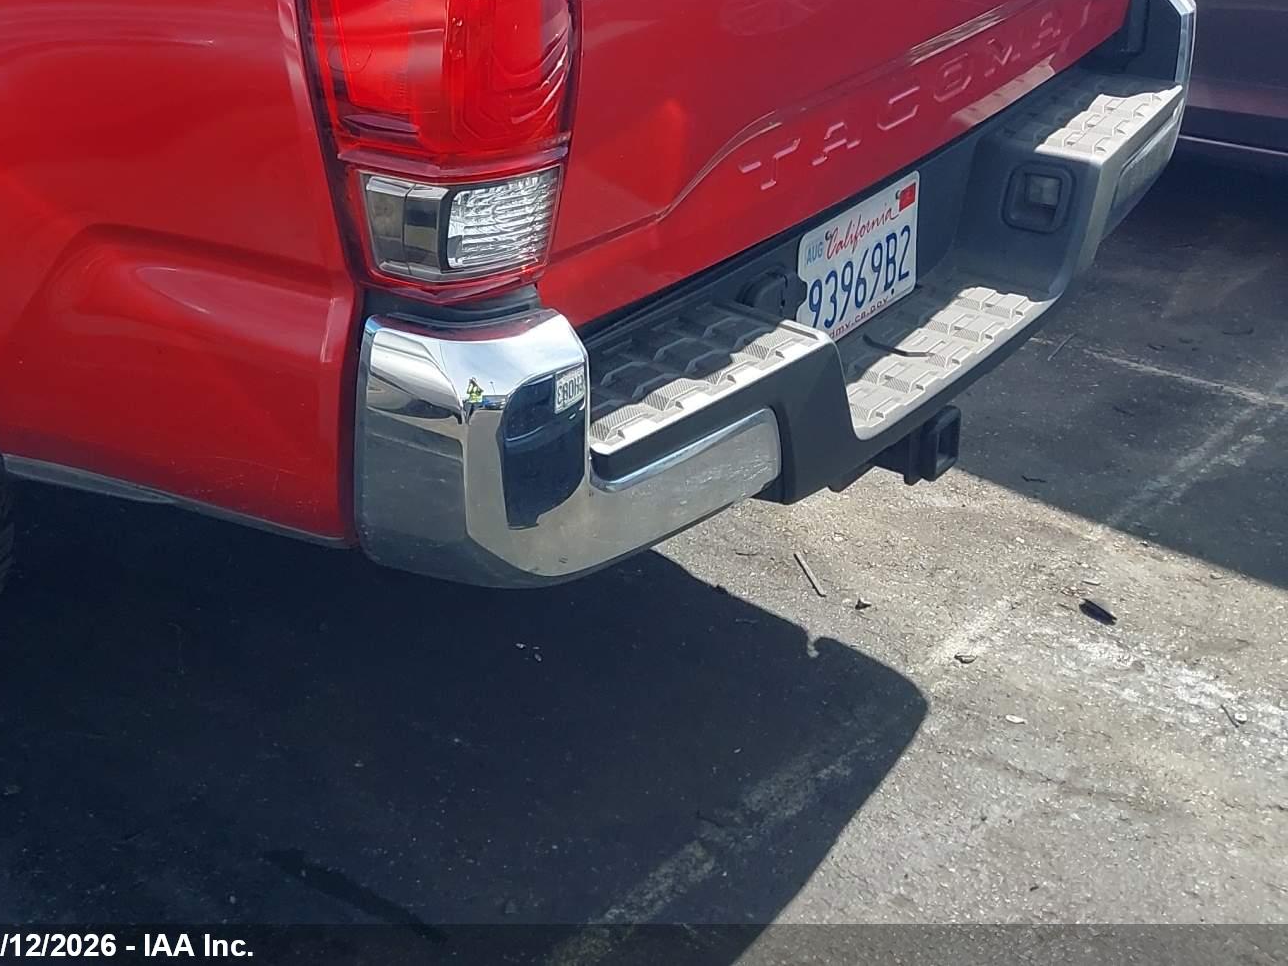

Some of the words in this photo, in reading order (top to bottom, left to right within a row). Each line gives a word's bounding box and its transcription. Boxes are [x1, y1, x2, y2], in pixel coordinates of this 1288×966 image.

[738, 11, 1061, 190] TACOMA
[806, 241, 824, 265] AUG
[825, 202, 900, 260] California
[808, 224, 911, 330] 93969B2
